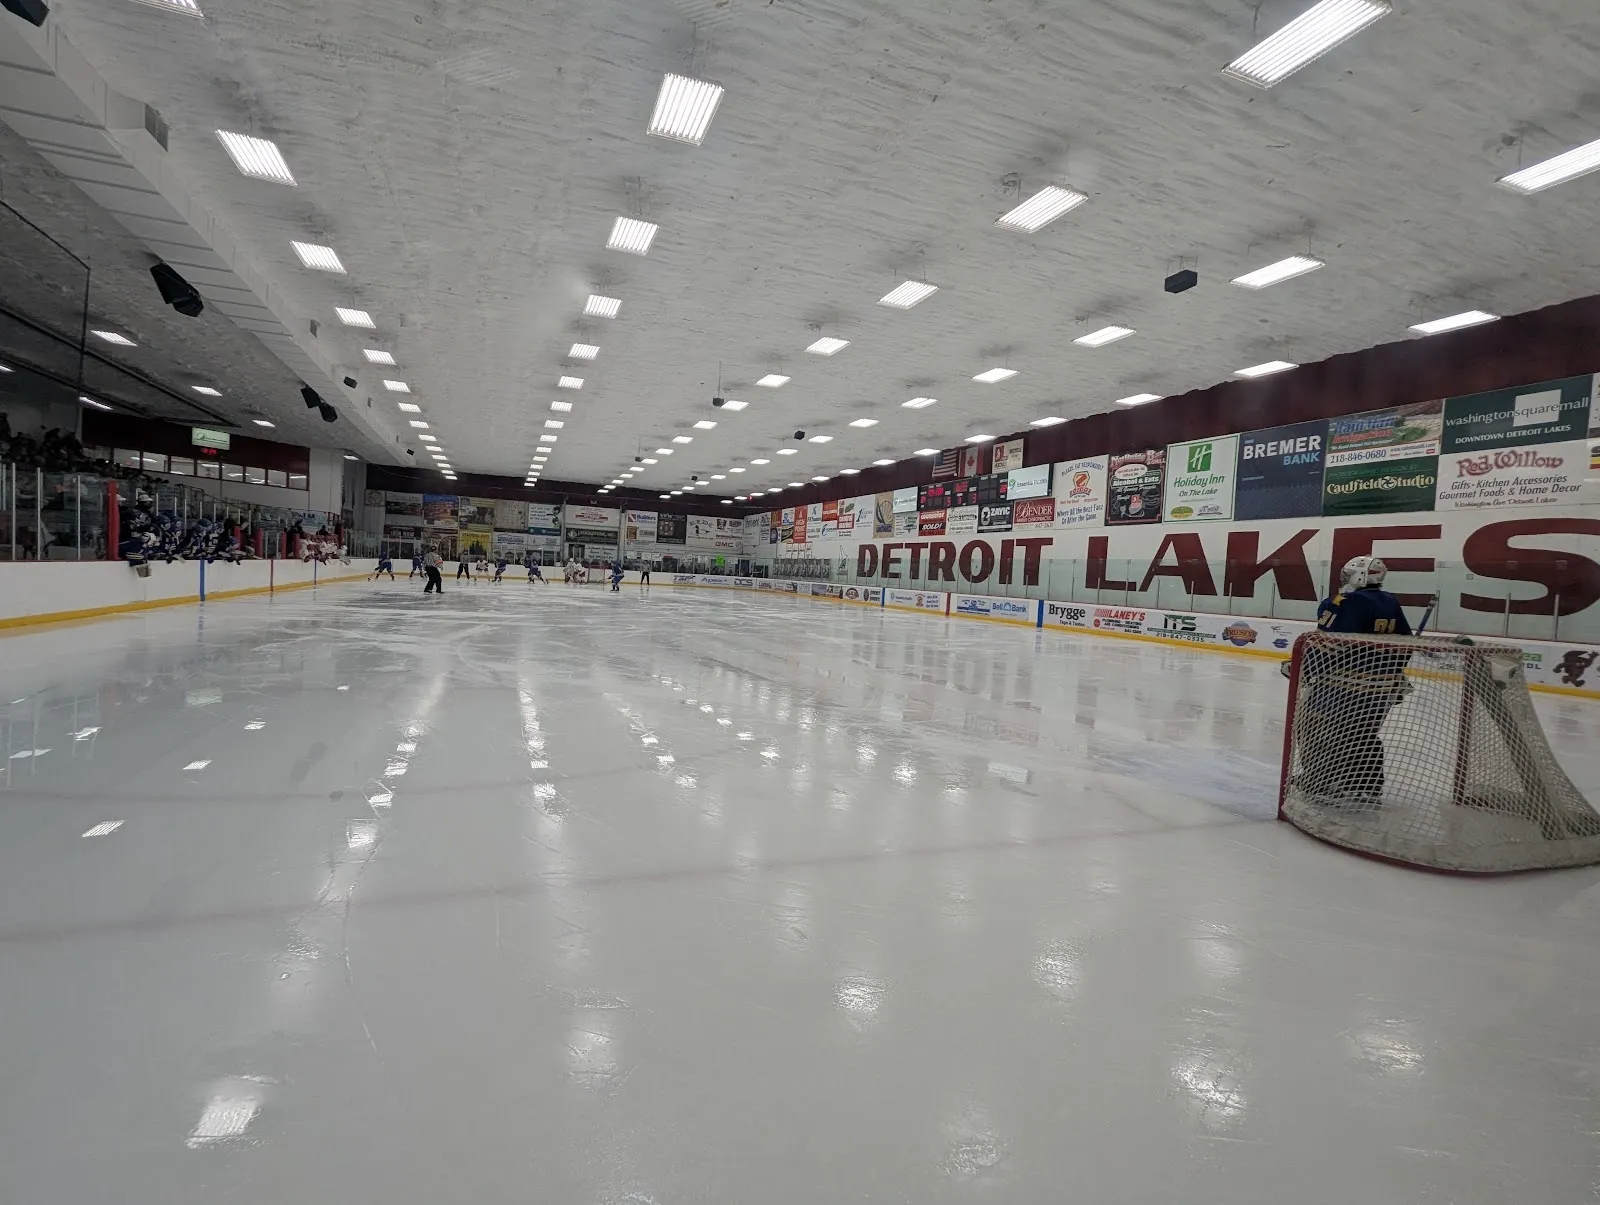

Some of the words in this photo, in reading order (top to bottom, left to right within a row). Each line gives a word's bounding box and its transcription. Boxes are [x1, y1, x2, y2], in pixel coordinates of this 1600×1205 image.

[1454, 433, 1504, 445] DOWNTOWN
[1506, 428, 1541, 439] DETROIT
[1544, 425, 1571, 434] LAKES
[1243, 435, 1321, 460] BREMER
[1283, 451, 1321, 465] BANK
[1330, 450, 1386, 464] 218-846-0680
[1456, 455, 1494, 478] Red
[1494, 450, 1565, 470] Willow
[1173, 475, 1208, 488] Holiday
[1209, 474, 1225, 485] Inn
[1327, 478, 1383, 494] Caulfield
[1391, 474, 1435, 488] Studio
[1451, 480, 1471, 491] Gifts
[1476, 478, 1510, 489] Kitchen
[1512, 474, 1567, 486] Accessories
[1189, 488, 1200, 497] The
[1201, 488, 1218, 496] Lake
[1439, 491, 1476, 500] Gourmet
[1479, 488, 1505, 498] Foods
[1510, 488, 1515, 496] &
[1518, 486, 1548, 496] Home
[1551, 484, 1582, 494] Decor
[1015, 501, 1052, 518] BENDER
[922, 523, 942, 531] SOLD!
[857, 537, 1054, 586] DETROIT
[1085, 517, 1600, 616] LAKES
[734, 578, 754, 586] DCS
[992, 602, 1003, 611] Bell
[1012, 604, 1027, 613] Bank
[1048, 604, 1085, 621] Brygge
[1108, 610, 1146, 622] LANEY'S
[1161, 613, 1197, 631] ITS
